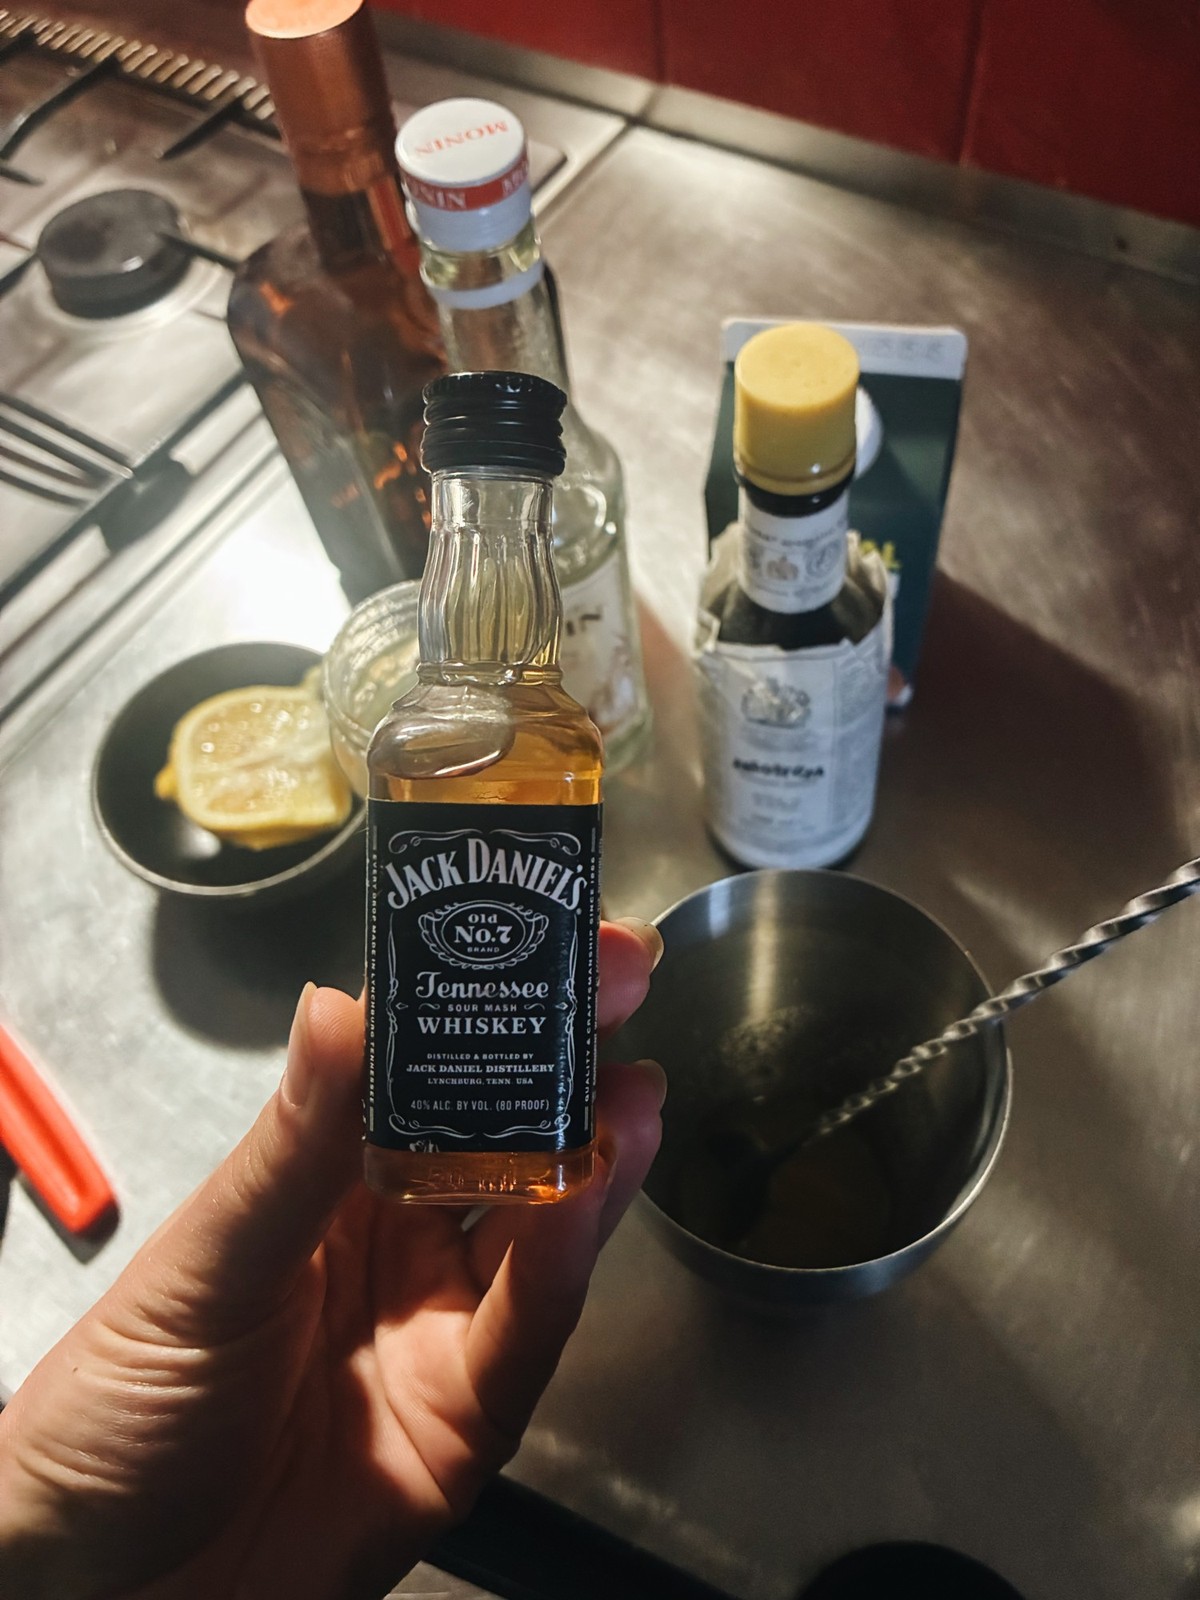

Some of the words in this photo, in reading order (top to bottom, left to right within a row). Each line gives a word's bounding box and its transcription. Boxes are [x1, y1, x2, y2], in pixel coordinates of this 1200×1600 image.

[414, 120, 510, 155] MONIN
[385, 851, 464, 909] JACK
[467, 838, 588, 911] DANIEL'S
[468, 913, 498, 924] Old
[370, 958, 377, 971] IN
[415, 971, 549, 998] Tennessee
[586, 929, 594, 1034] CRAFTSMANSHIP
[369, 972, 377, 1038] LYNCHBURG
[447, 1004, 479, 1012] SOUR
[484, 1004, 518, 1012] MASH
[417, 1016, 547, 1035] WHISKEY
[368, 1041, 376, 1103] TENNESSEE
[406, 1064, 437, 1073] JACK
[439, 1064, 483, 1073] DANIEL
[485, 1063, 555, 1073] DISTILLERY
[410, 1100, 430, 1111] 40%
[456, 1100, 470, 1111] BY
[514, 1099, 550, 1112] PROOF)
